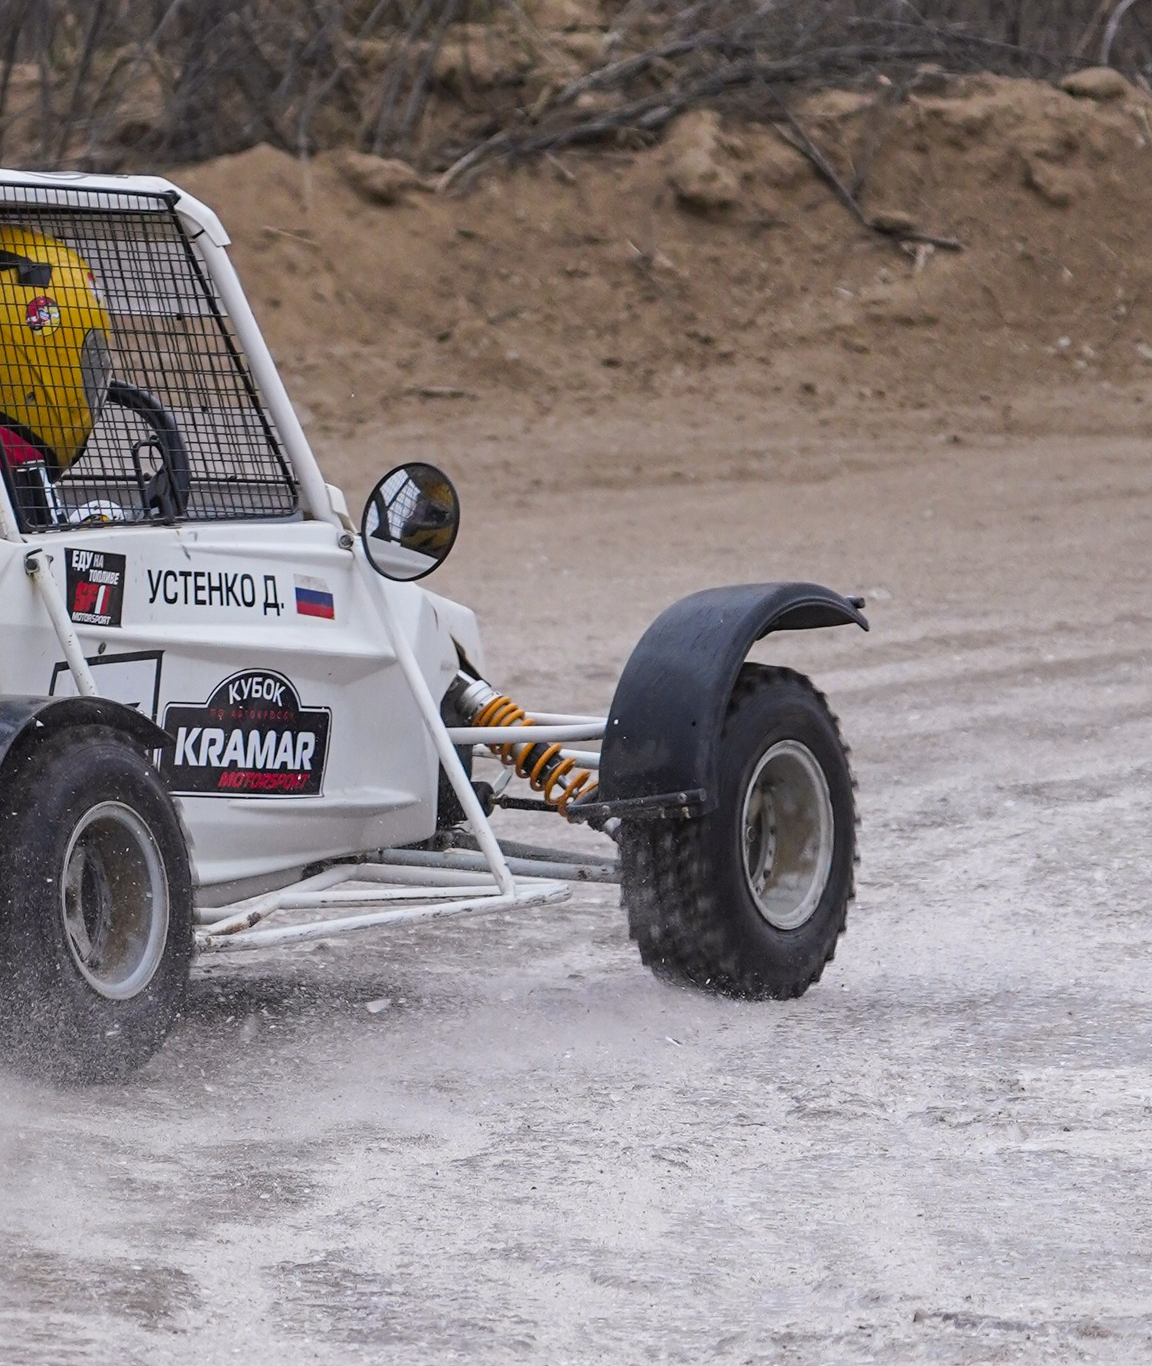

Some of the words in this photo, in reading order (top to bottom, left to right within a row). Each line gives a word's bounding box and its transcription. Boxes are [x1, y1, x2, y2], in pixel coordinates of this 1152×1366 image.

[72, 550, 93, 572] ЕДУ
[93, 554, 104, 568] НА
[147, 569, 256, 607] УСТЕНКО
[263, 575, 284, 616] Д.
[72, 612, 111, 625] MOTORSPORT
[228, 677, 286, 707] КУБОК
[174, 727, 316, 770] KRAMAR
[218, 771, 311, 790] MOTORSPORT
